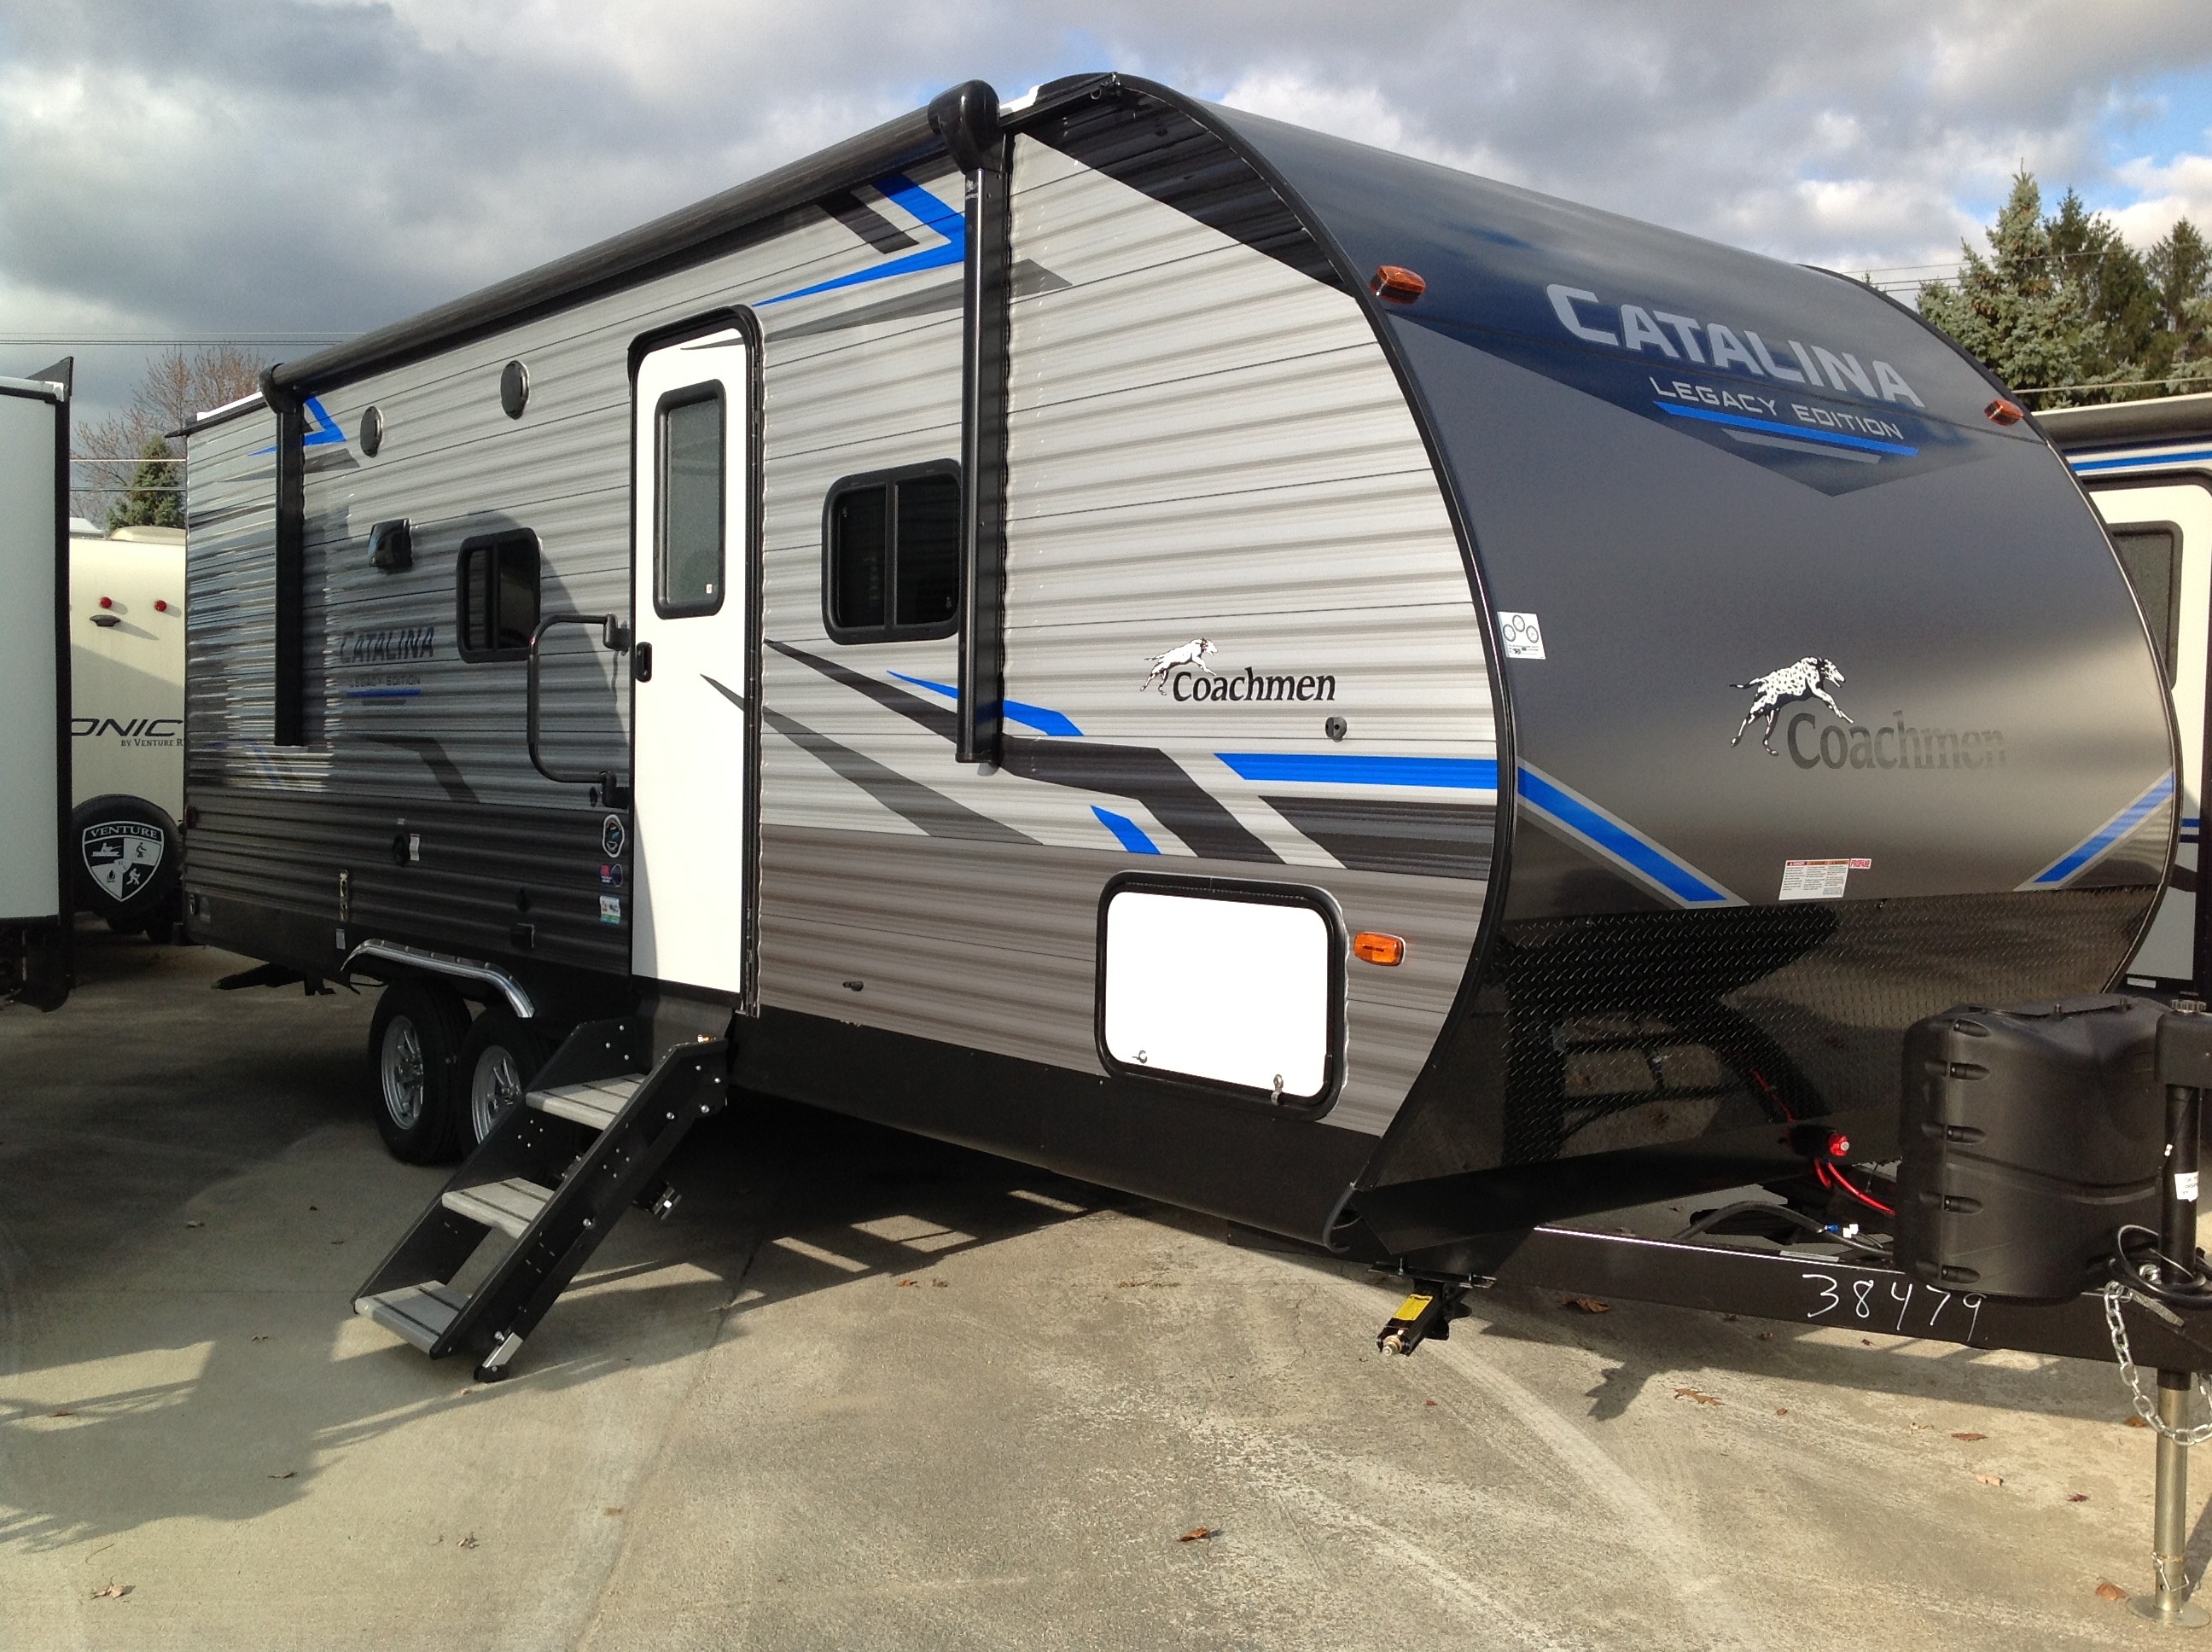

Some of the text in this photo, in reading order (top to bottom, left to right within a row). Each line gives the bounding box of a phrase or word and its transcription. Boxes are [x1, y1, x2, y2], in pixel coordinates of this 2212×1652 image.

[1546, 284, 1925, 408] CATALINA
[1649, 376, 1905, 440] LEGACY EDITION
[340, 626, 434, 664] CATALINA
[1173, 666, 1336, 701] Coachmen
[1787, 709, 2005, 770] Coachmen
[90, 825, 158, 840] VENTURE
[1802, 1273, 1988, 1343] 38479
